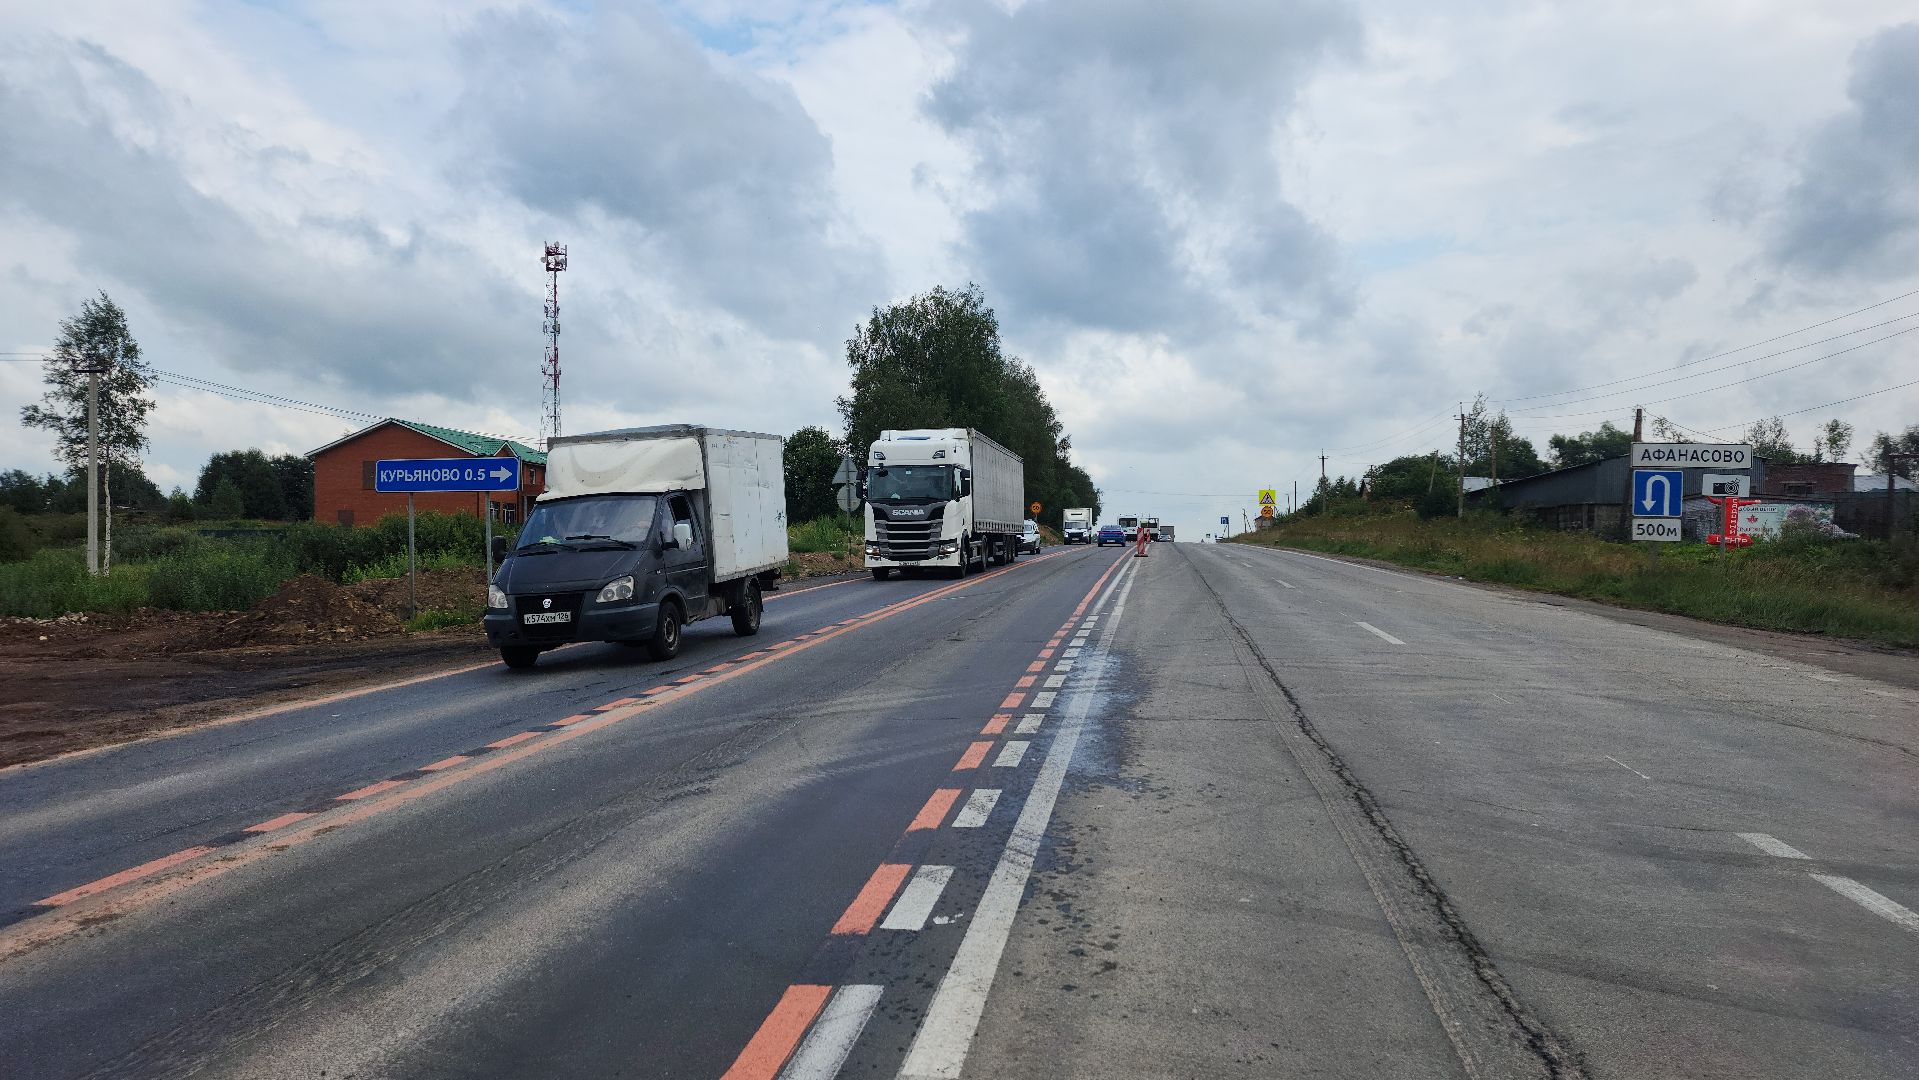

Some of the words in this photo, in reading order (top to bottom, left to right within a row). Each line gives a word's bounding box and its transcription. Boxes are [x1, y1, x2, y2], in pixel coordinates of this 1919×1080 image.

[1641, 449, 1744, 463] АФАНАСОВО
[380, 468, 460, 482] КУРЬЯНОВО
[464, 468, 486, 481] 0.5
